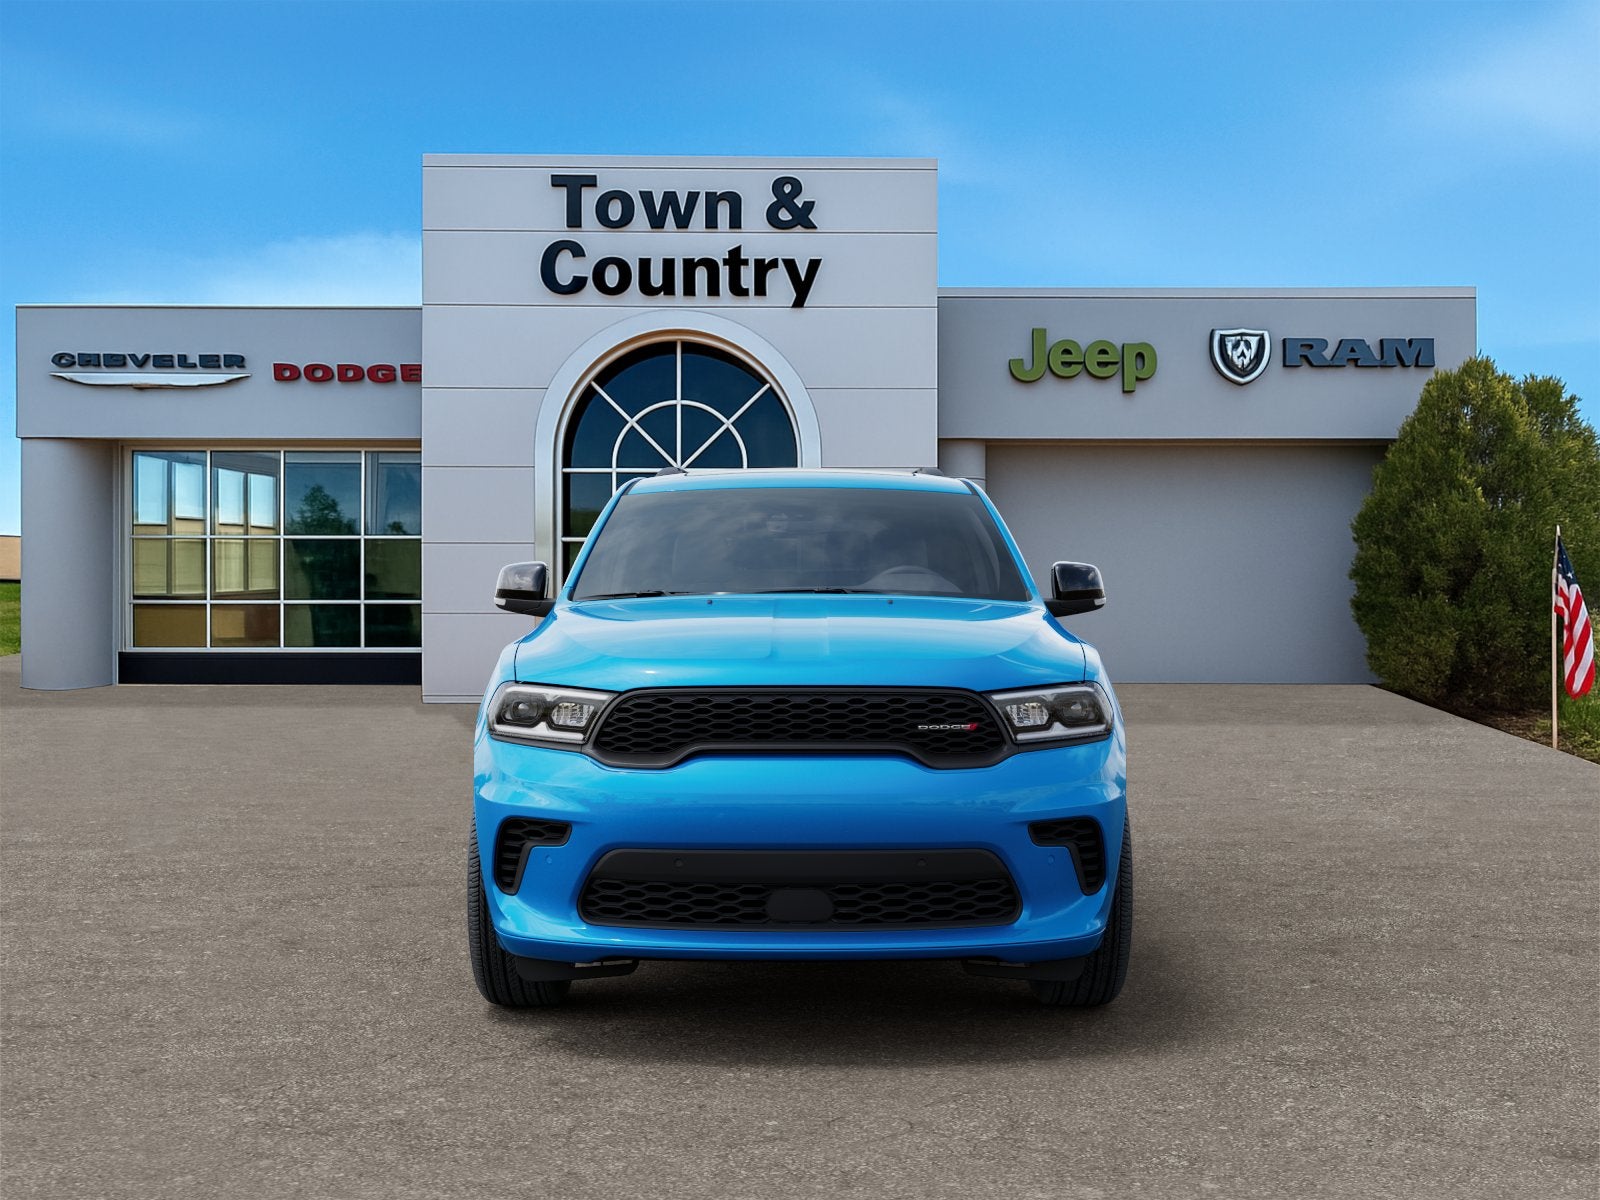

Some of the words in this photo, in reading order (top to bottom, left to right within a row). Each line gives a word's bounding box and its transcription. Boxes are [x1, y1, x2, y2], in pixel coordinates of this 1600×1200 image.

[550, 174, 743, 230] Town
[766, 175, 819, 230] &
[540, 239, 822, 308] Country
[273, 363, 422, 383] DODGE
[1009, 328, 1157, 393] Jeep
[1283, 337, 1435, 368] RAM
